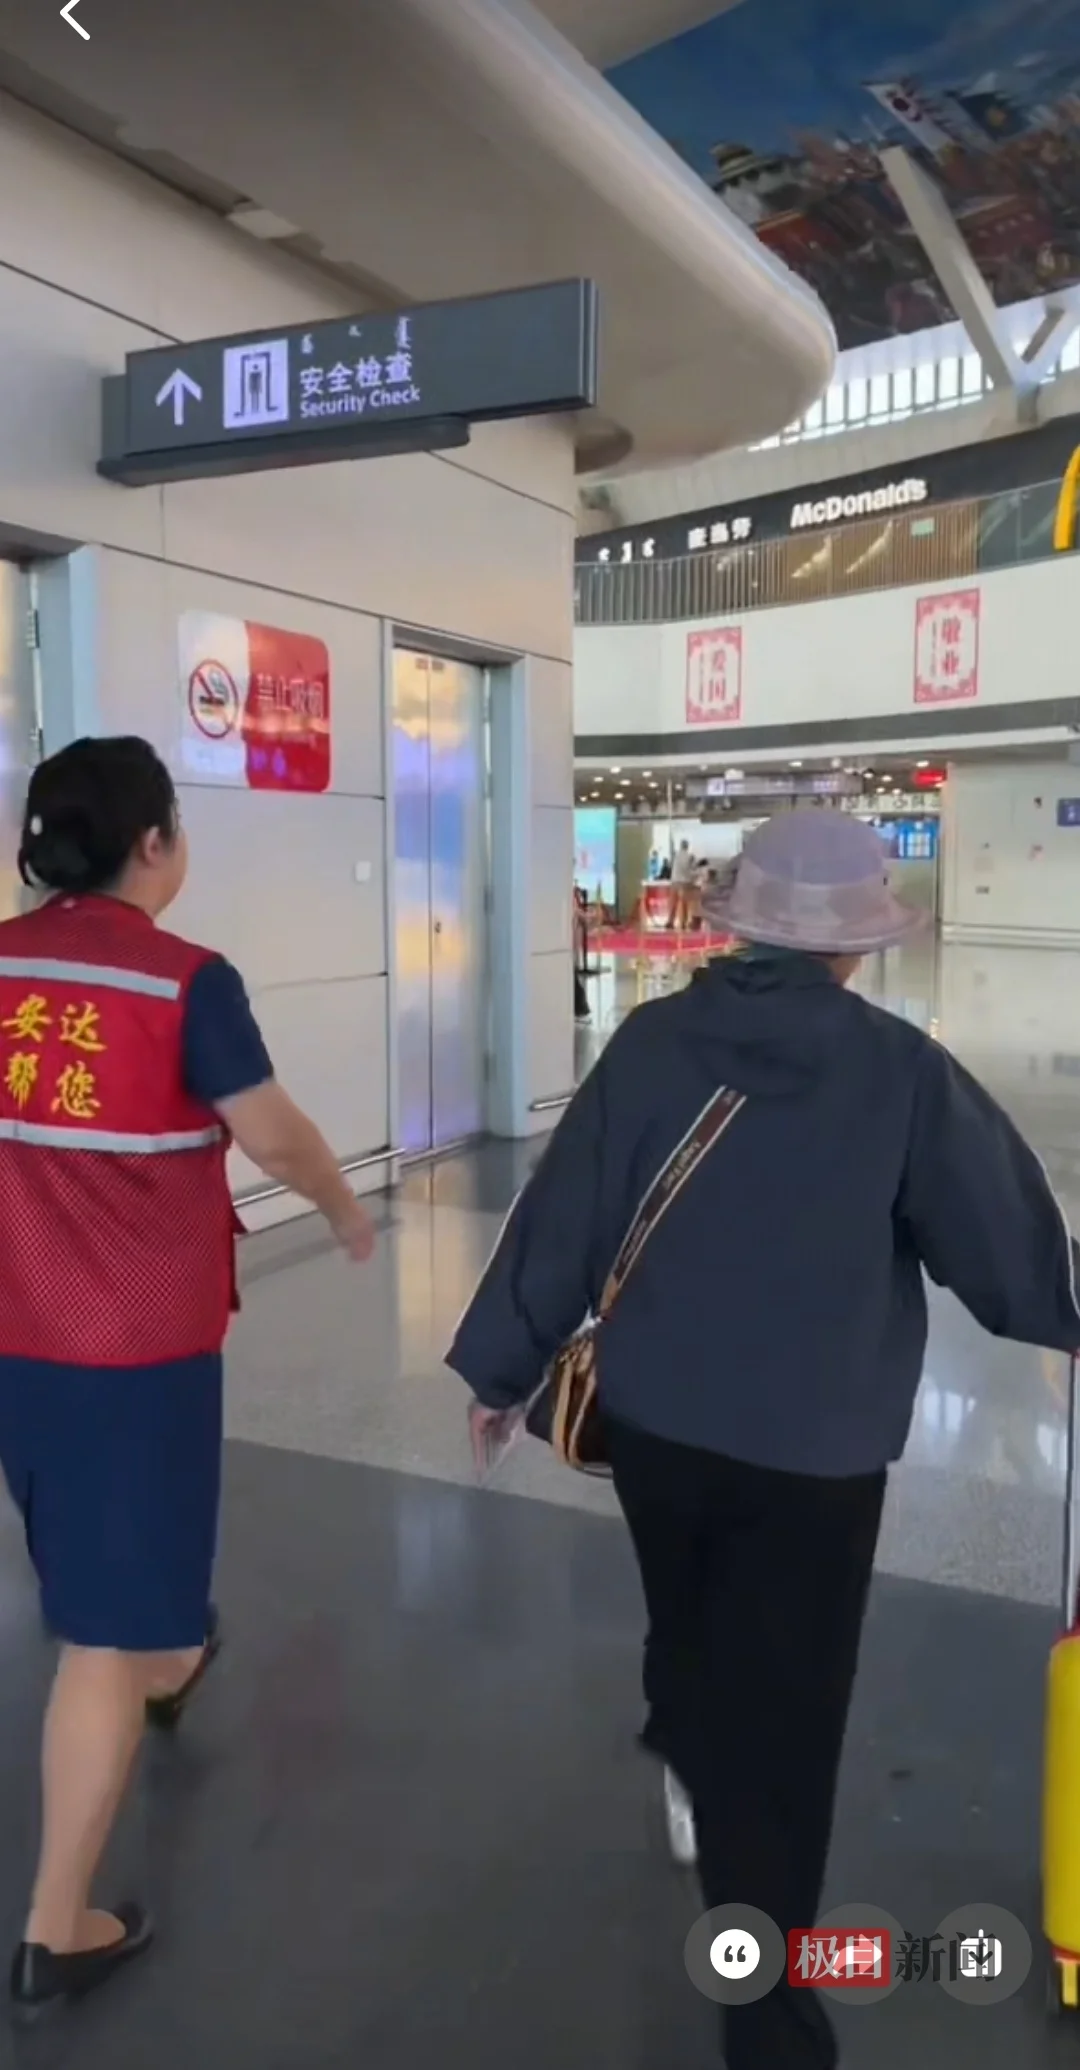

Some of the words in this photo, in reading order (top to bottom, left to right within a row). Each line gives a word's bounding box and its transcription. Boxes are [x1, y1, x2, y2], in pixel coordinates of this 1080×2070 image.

[300, 353, 413, 398] 安全检查
[300, 394, 366, 418] Security
[369, 384, 420, 407] Check
[790, 477, 928, 529] McDonald's
[1, 993, 107, 1051] 安达
[3, 1051, 102, 1118] 帮您
